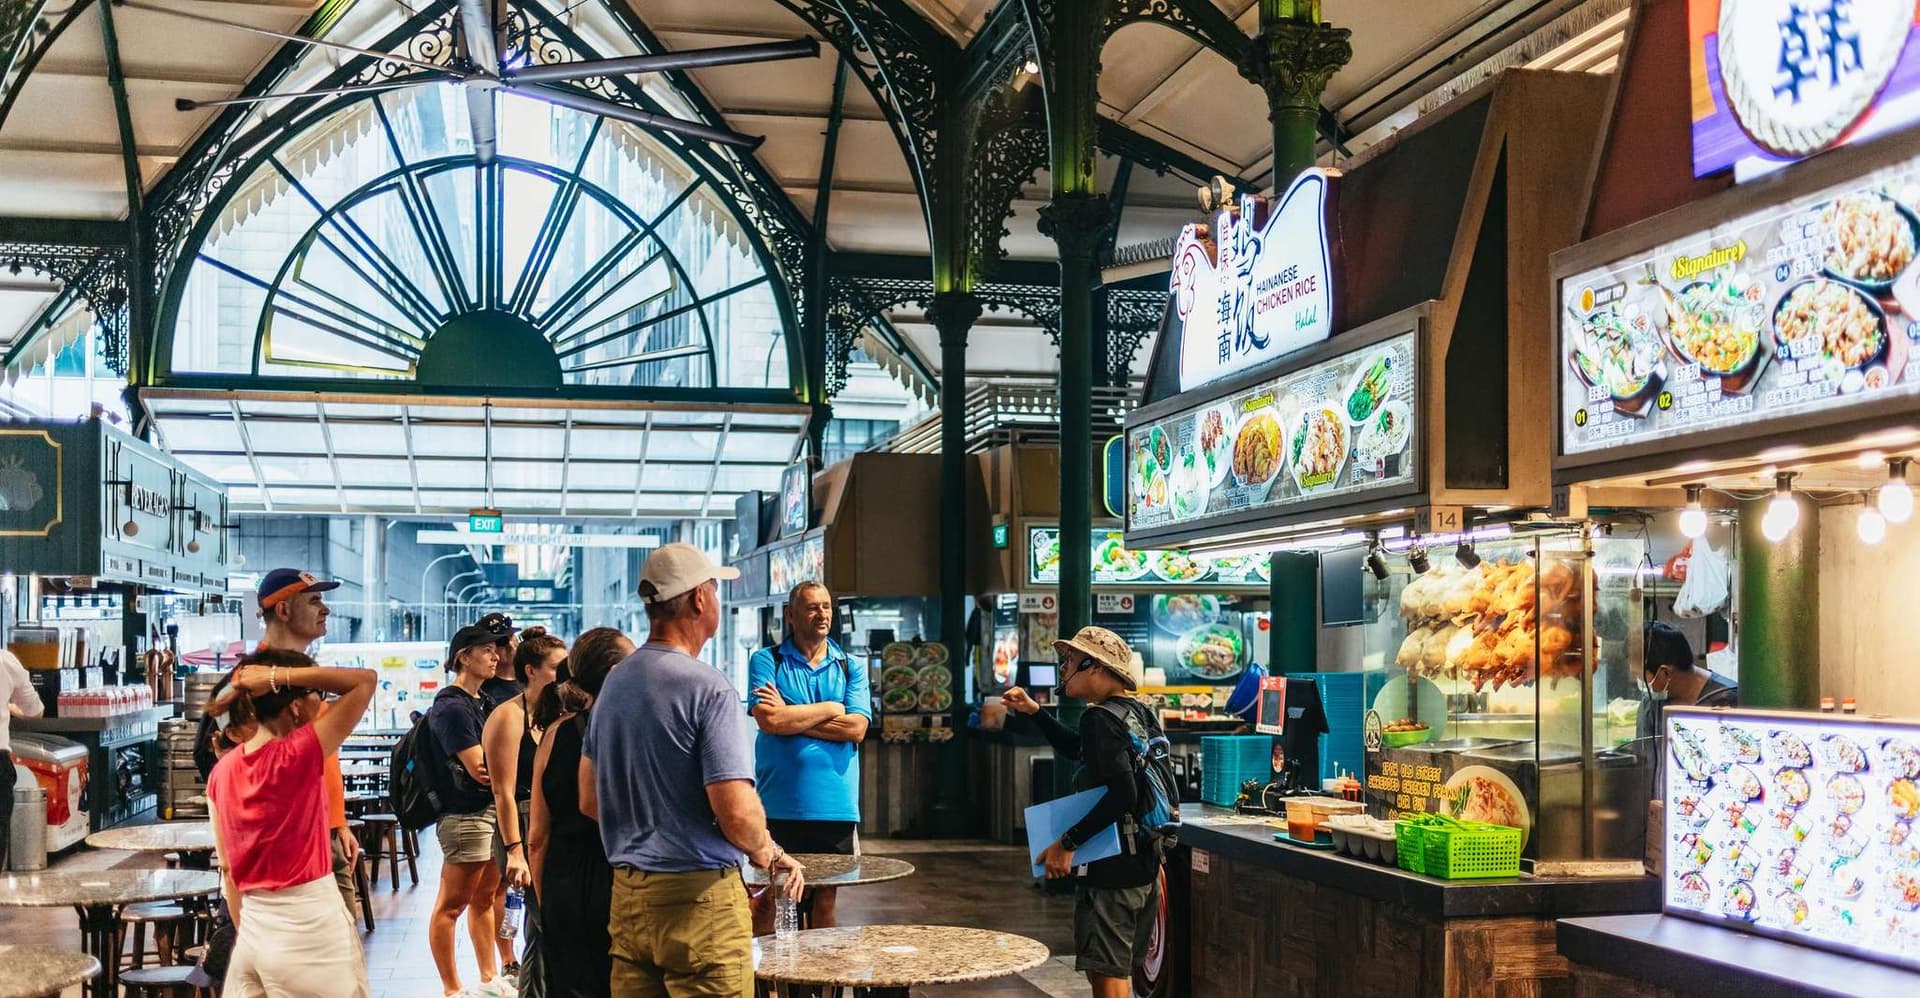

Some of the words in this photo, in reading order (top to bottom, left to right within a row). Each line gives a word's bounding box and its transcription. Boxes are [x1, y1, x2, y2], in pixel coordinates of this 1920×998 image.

[1676, 245, 1739, 280] Signature
[1256, 264, 1299, 296] HAINANESE
[1777, 266, 1789, 279] 04
[1256, 285, 1294, 315] CHICKEN
[1294, 274, 1317, 299] RICE
[1295, 304, 1317, 331] Halal
[1778, 345, 1790, 358] 03
[1660, 392, 1671, 408] 02
[1576, 410, 1586, 425] 01
[475, 519, 496, 531] EXIT
[1436, 511, 1457, 528] 14
[523, 534, 561, 545] HEIGHT
[1401, 763, 1414, 778] OLD
[1416, 765, 1442, 782] STREET
[1368, 775, 1400, 792] SHREDDED
[1402, 780, 1430, 797] CHICKEN
[1412, 796, 1426, 811] FUN
